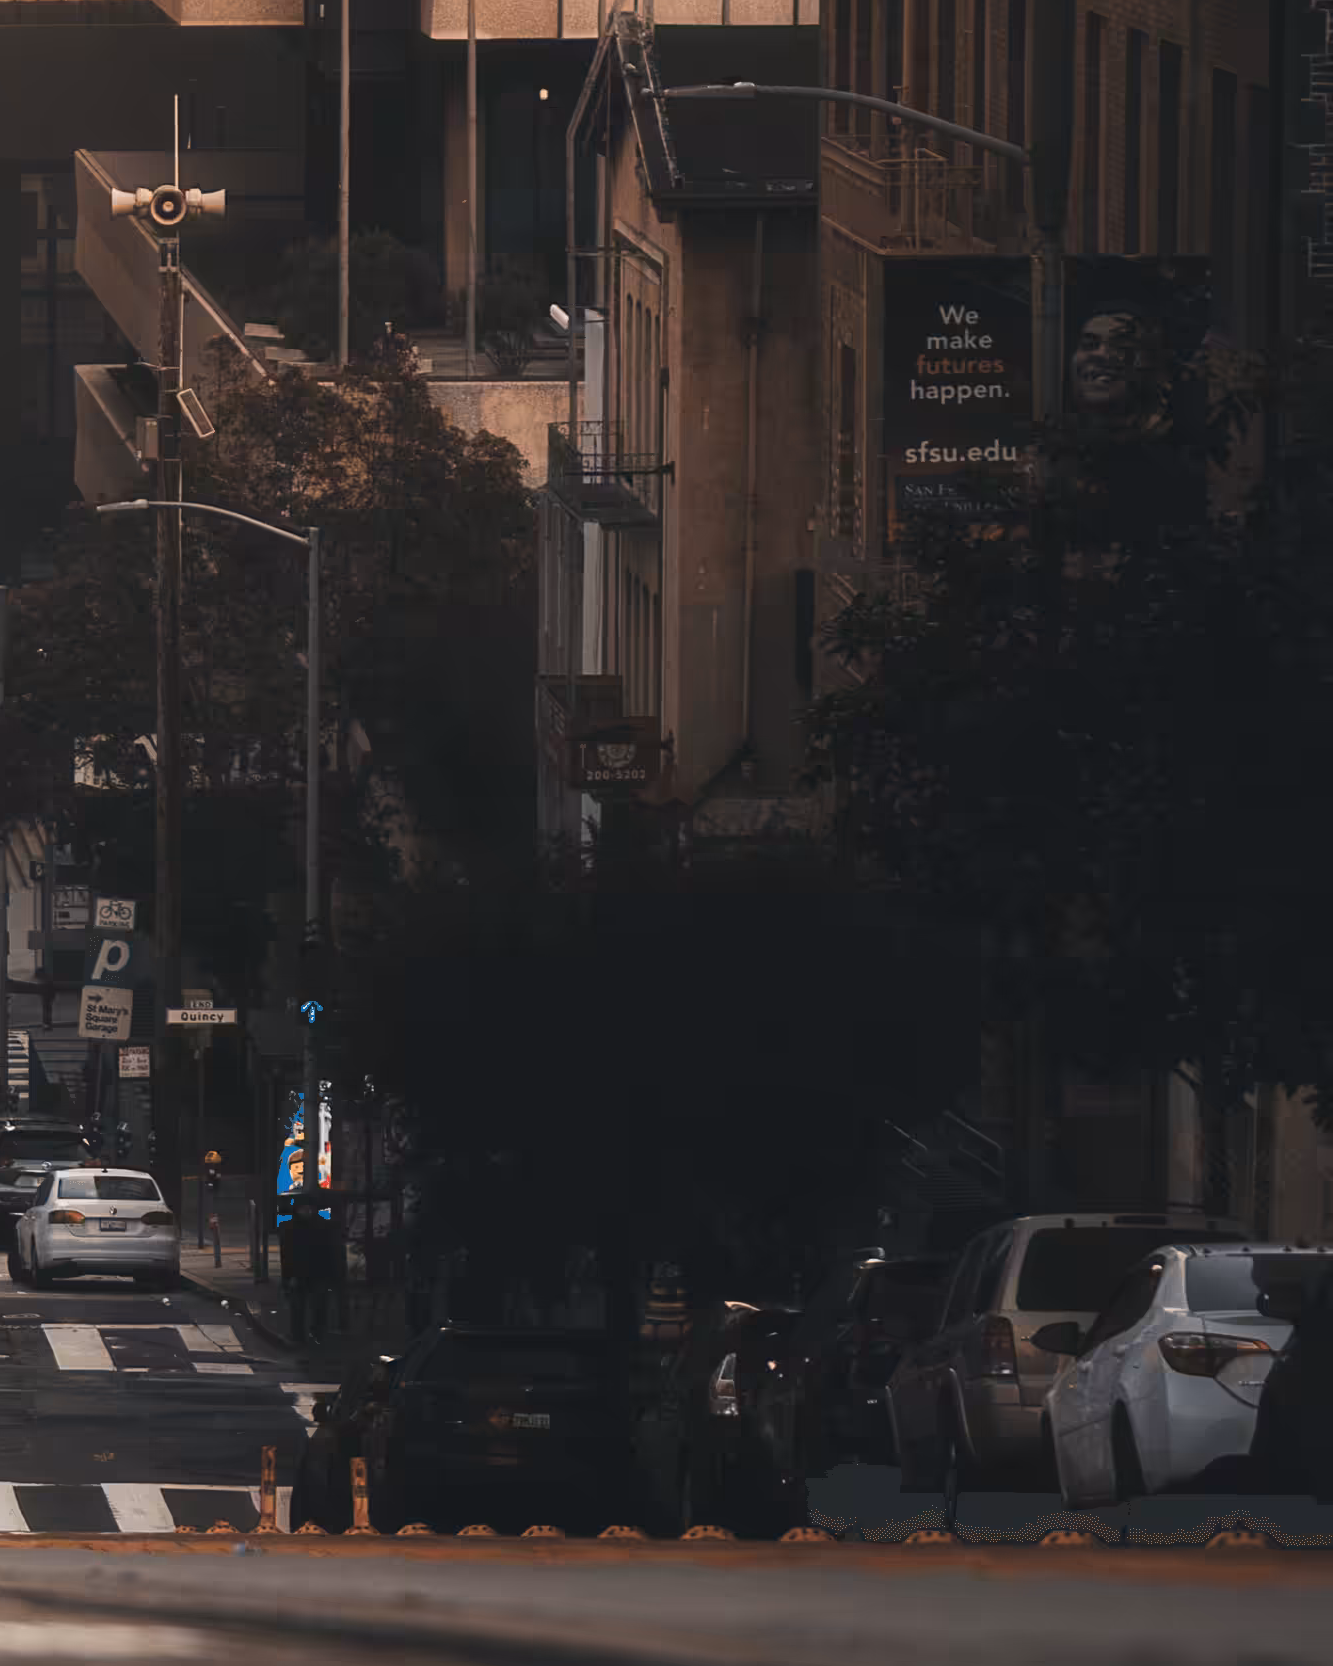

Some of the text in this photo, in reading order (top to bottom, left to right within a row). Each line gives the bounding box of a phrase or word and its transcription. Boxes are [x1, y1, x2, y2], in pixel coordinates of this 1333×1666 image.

[939, 304, 981, 325] We
[926, 326, 993, 349] make
[916, 354, 1005, 377] futures
[909, 379, 1010, 405] happen.
[904, 438, 1018, 463] sfsu.edu
[91, 938, 130, 980] P
[85, 1022, 118, 1034] Garage
[86, 1013, 118, 1024] Square
[181, 1012, 224, 1022] Quincy
